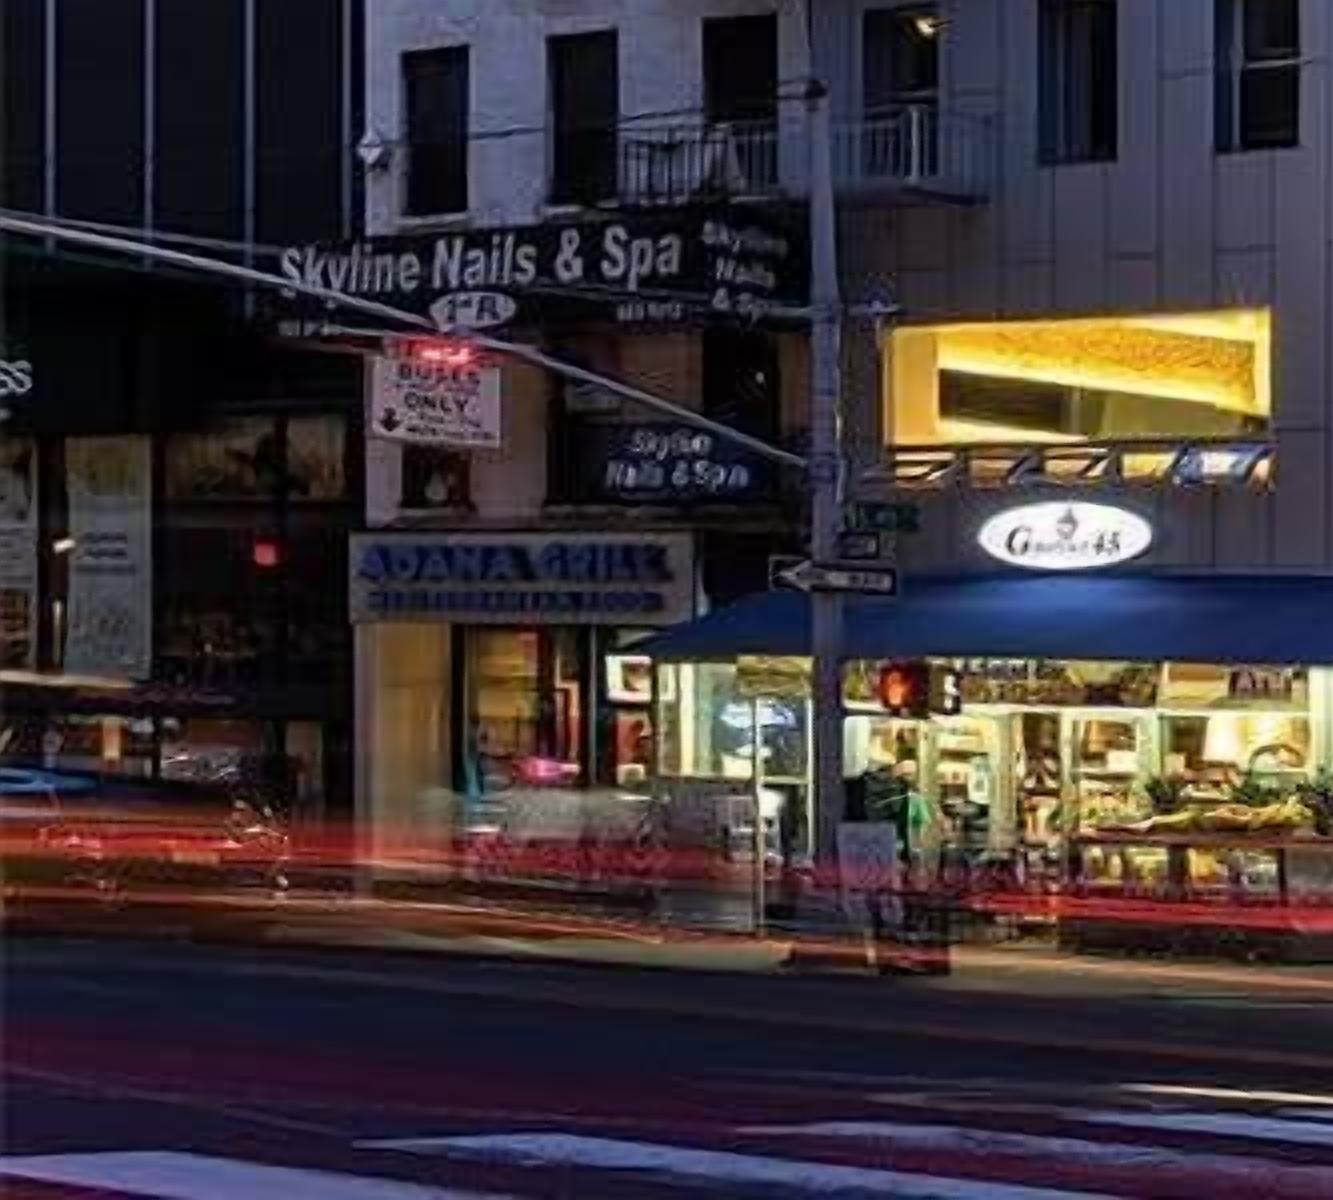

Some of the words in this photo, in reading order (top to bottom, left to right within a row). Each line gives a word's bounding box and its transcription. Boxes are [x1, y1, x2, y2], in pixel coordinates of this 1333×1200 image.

[281, 242, 421, 308] Skyline
[431, 233, 536, 286] Nails
[555, 228, 583, 282] &
[601, 225, 683, 291] Spa
[404, 390, 468, 412] ONLY
